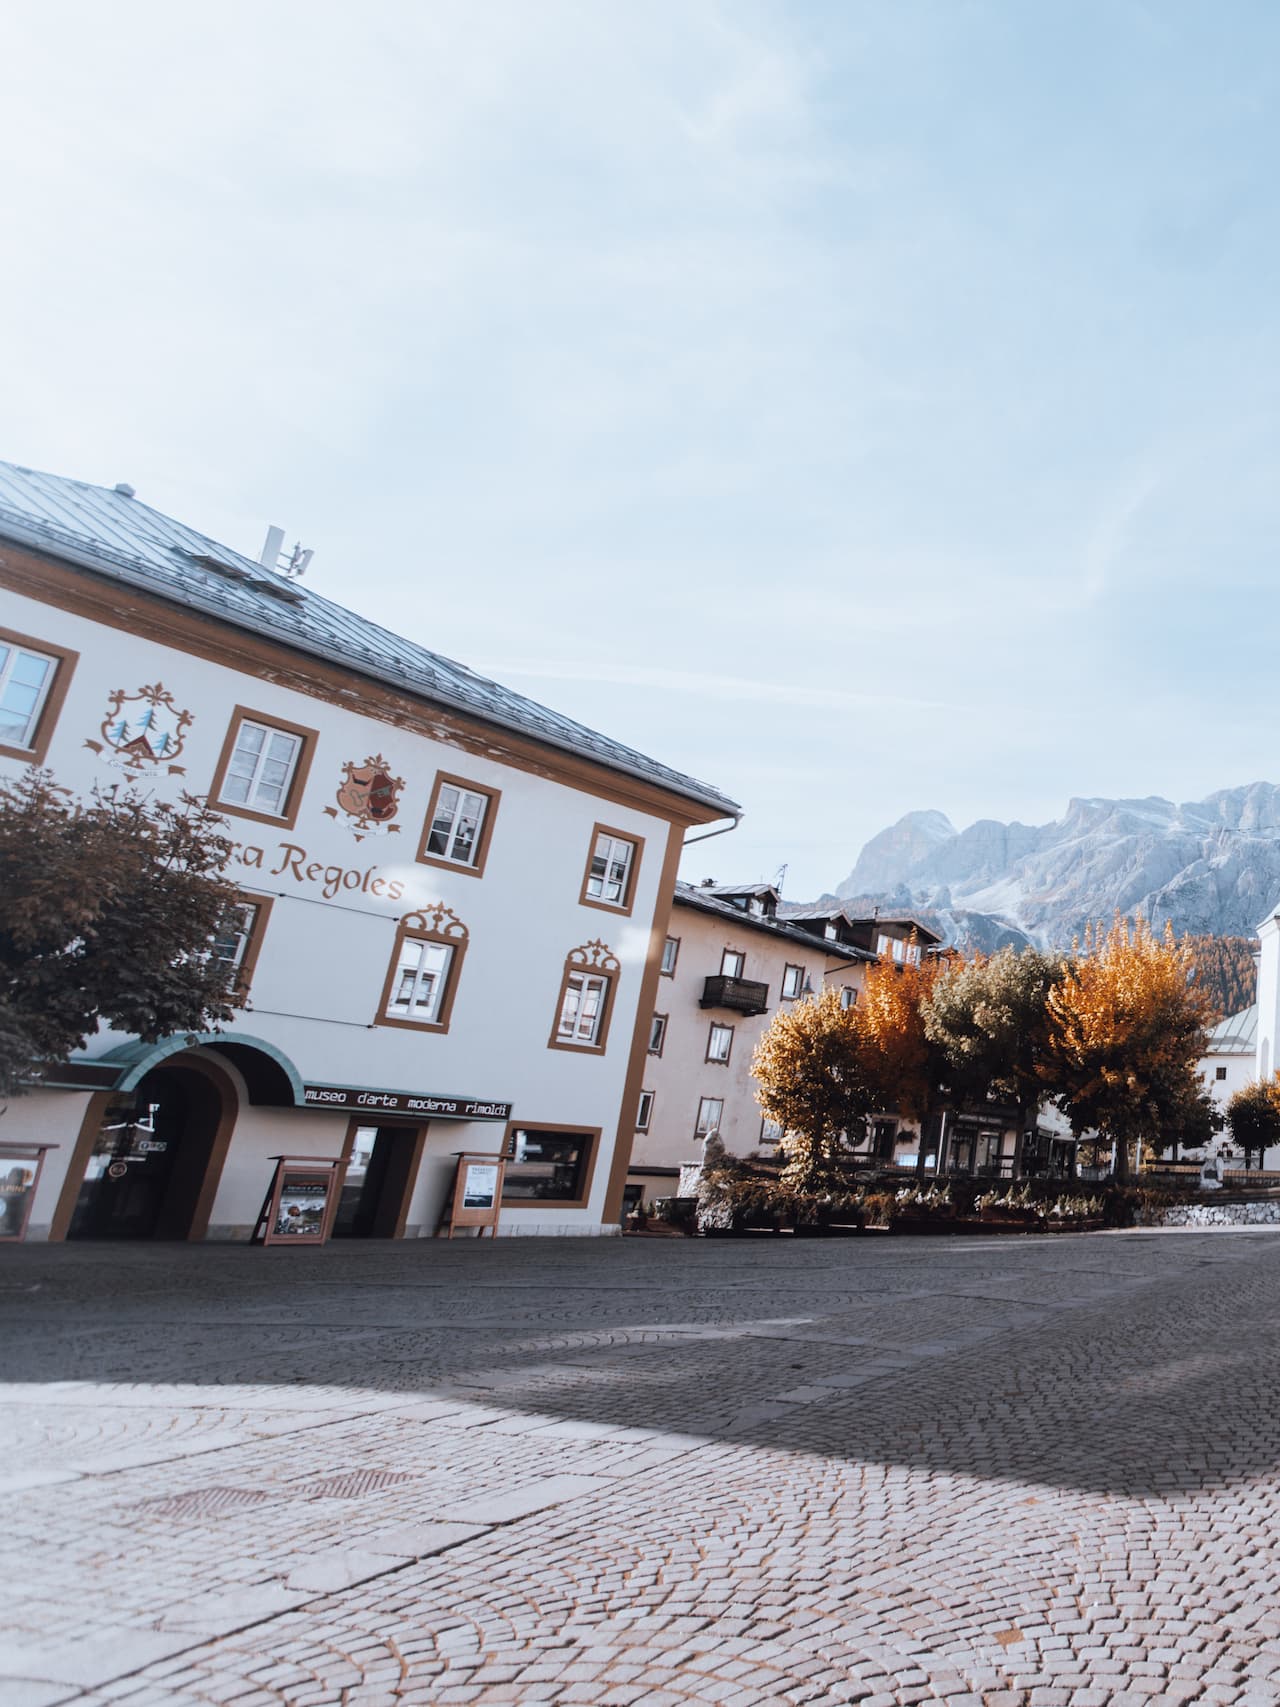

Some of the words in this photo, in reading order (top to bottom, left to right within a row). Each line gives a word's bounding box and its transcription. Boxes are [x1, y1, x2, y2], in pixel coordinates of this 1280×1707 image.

[270, 843, 404, 900] Regoles
[304, 1090, 346, 1104] museo
[357, 1093, 398, 1107] d'arte
[407, 1099, 457, 1113] moderna
[465, 1104, 507, 1116] rimoldi
